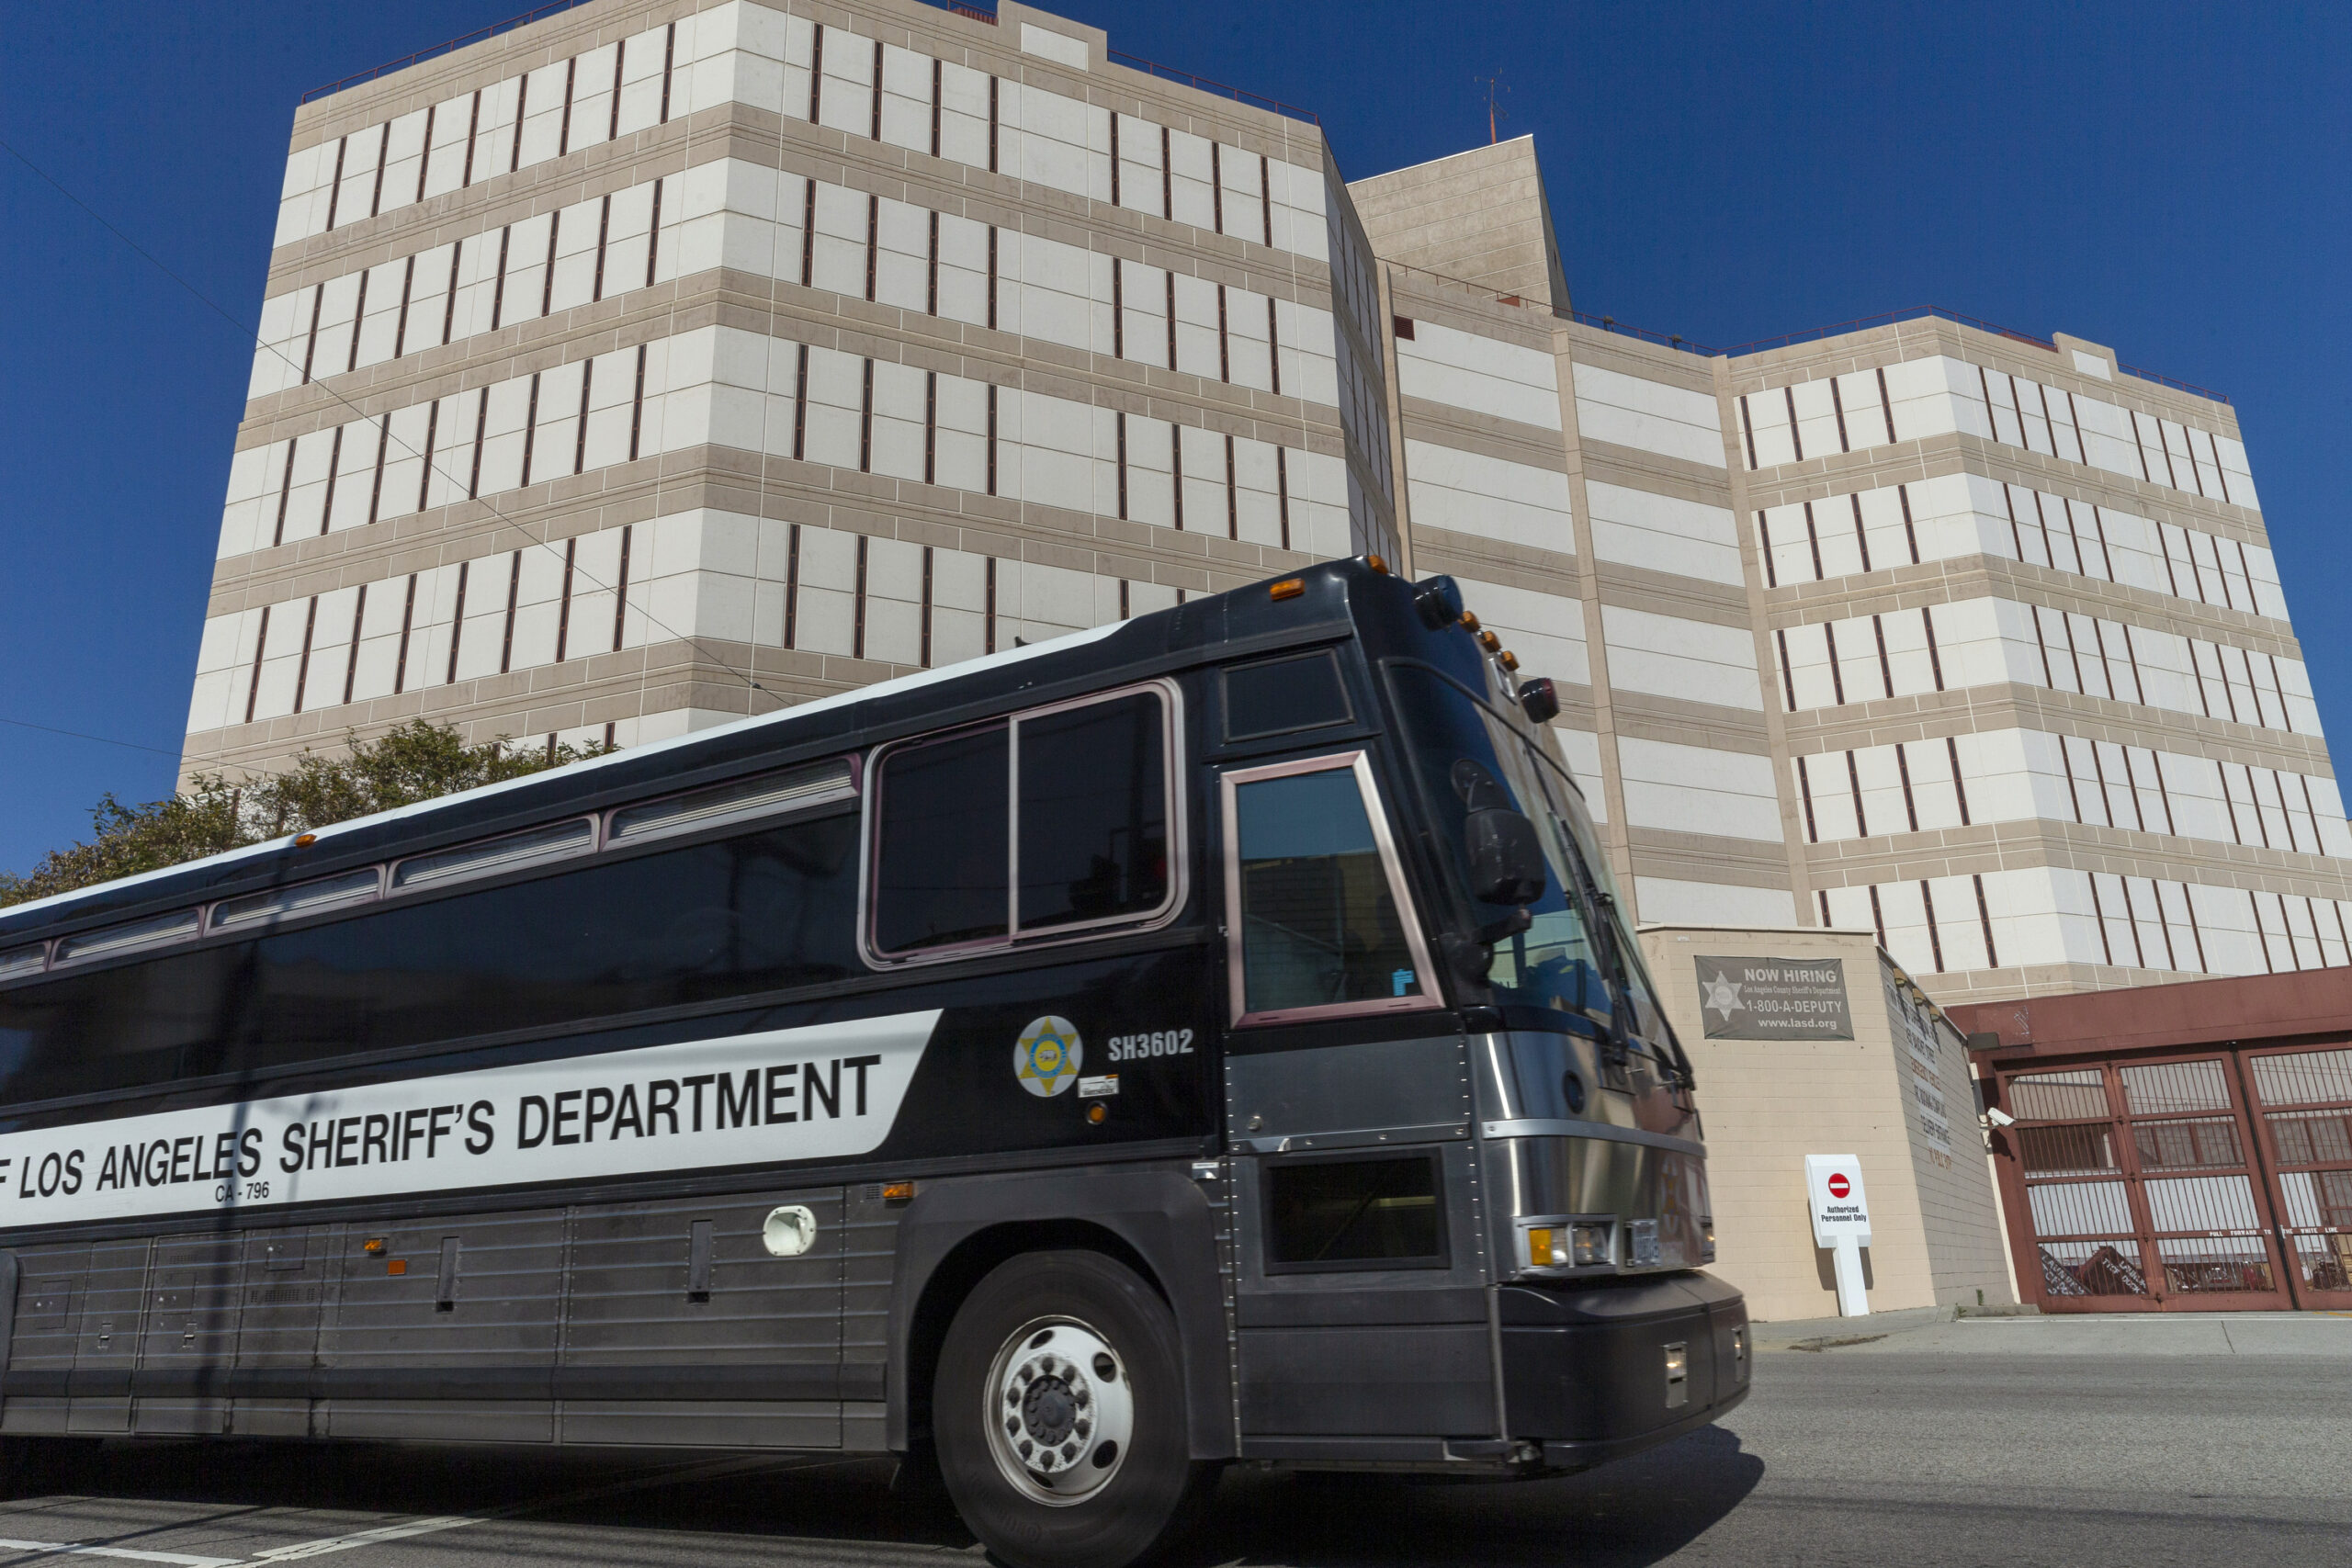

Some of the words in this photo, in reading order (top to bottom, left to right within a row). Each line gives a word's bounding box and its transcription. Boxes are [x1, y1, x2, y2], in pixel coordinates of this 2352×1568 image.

[1744, 968, 1779, 982] NOW
[1783, 969, 1837, 983] HIRING
[1744, 985, 1753, 993] Los
[1754, 986, 1772, 996] Angeles
[1773, 986, 1791, 996] County
[1746, 999, 1842, 1013] 1-800-A-DEPUTY
[1758, 1018, 1838, 1030] www.lasd.org
[1108, 1028, 1194, 1061] SH3602
[19, 1149, 85, 1199] LOS
[96, 1128, 263, 1190] ANGELES
[279, 1100, 494, 1173] SHERIFF'S
[517, 1055, 881, 1149] DEPARTMENT
[215, 1184, 234, 1202] CA
[246, 1181, 270, 1200] 796
[1826, 1205, 1860, 1213] Authorized
[1821, 1214, 1852, 1223] Personnel
[1853, 1213, 1867, 1223] Only
